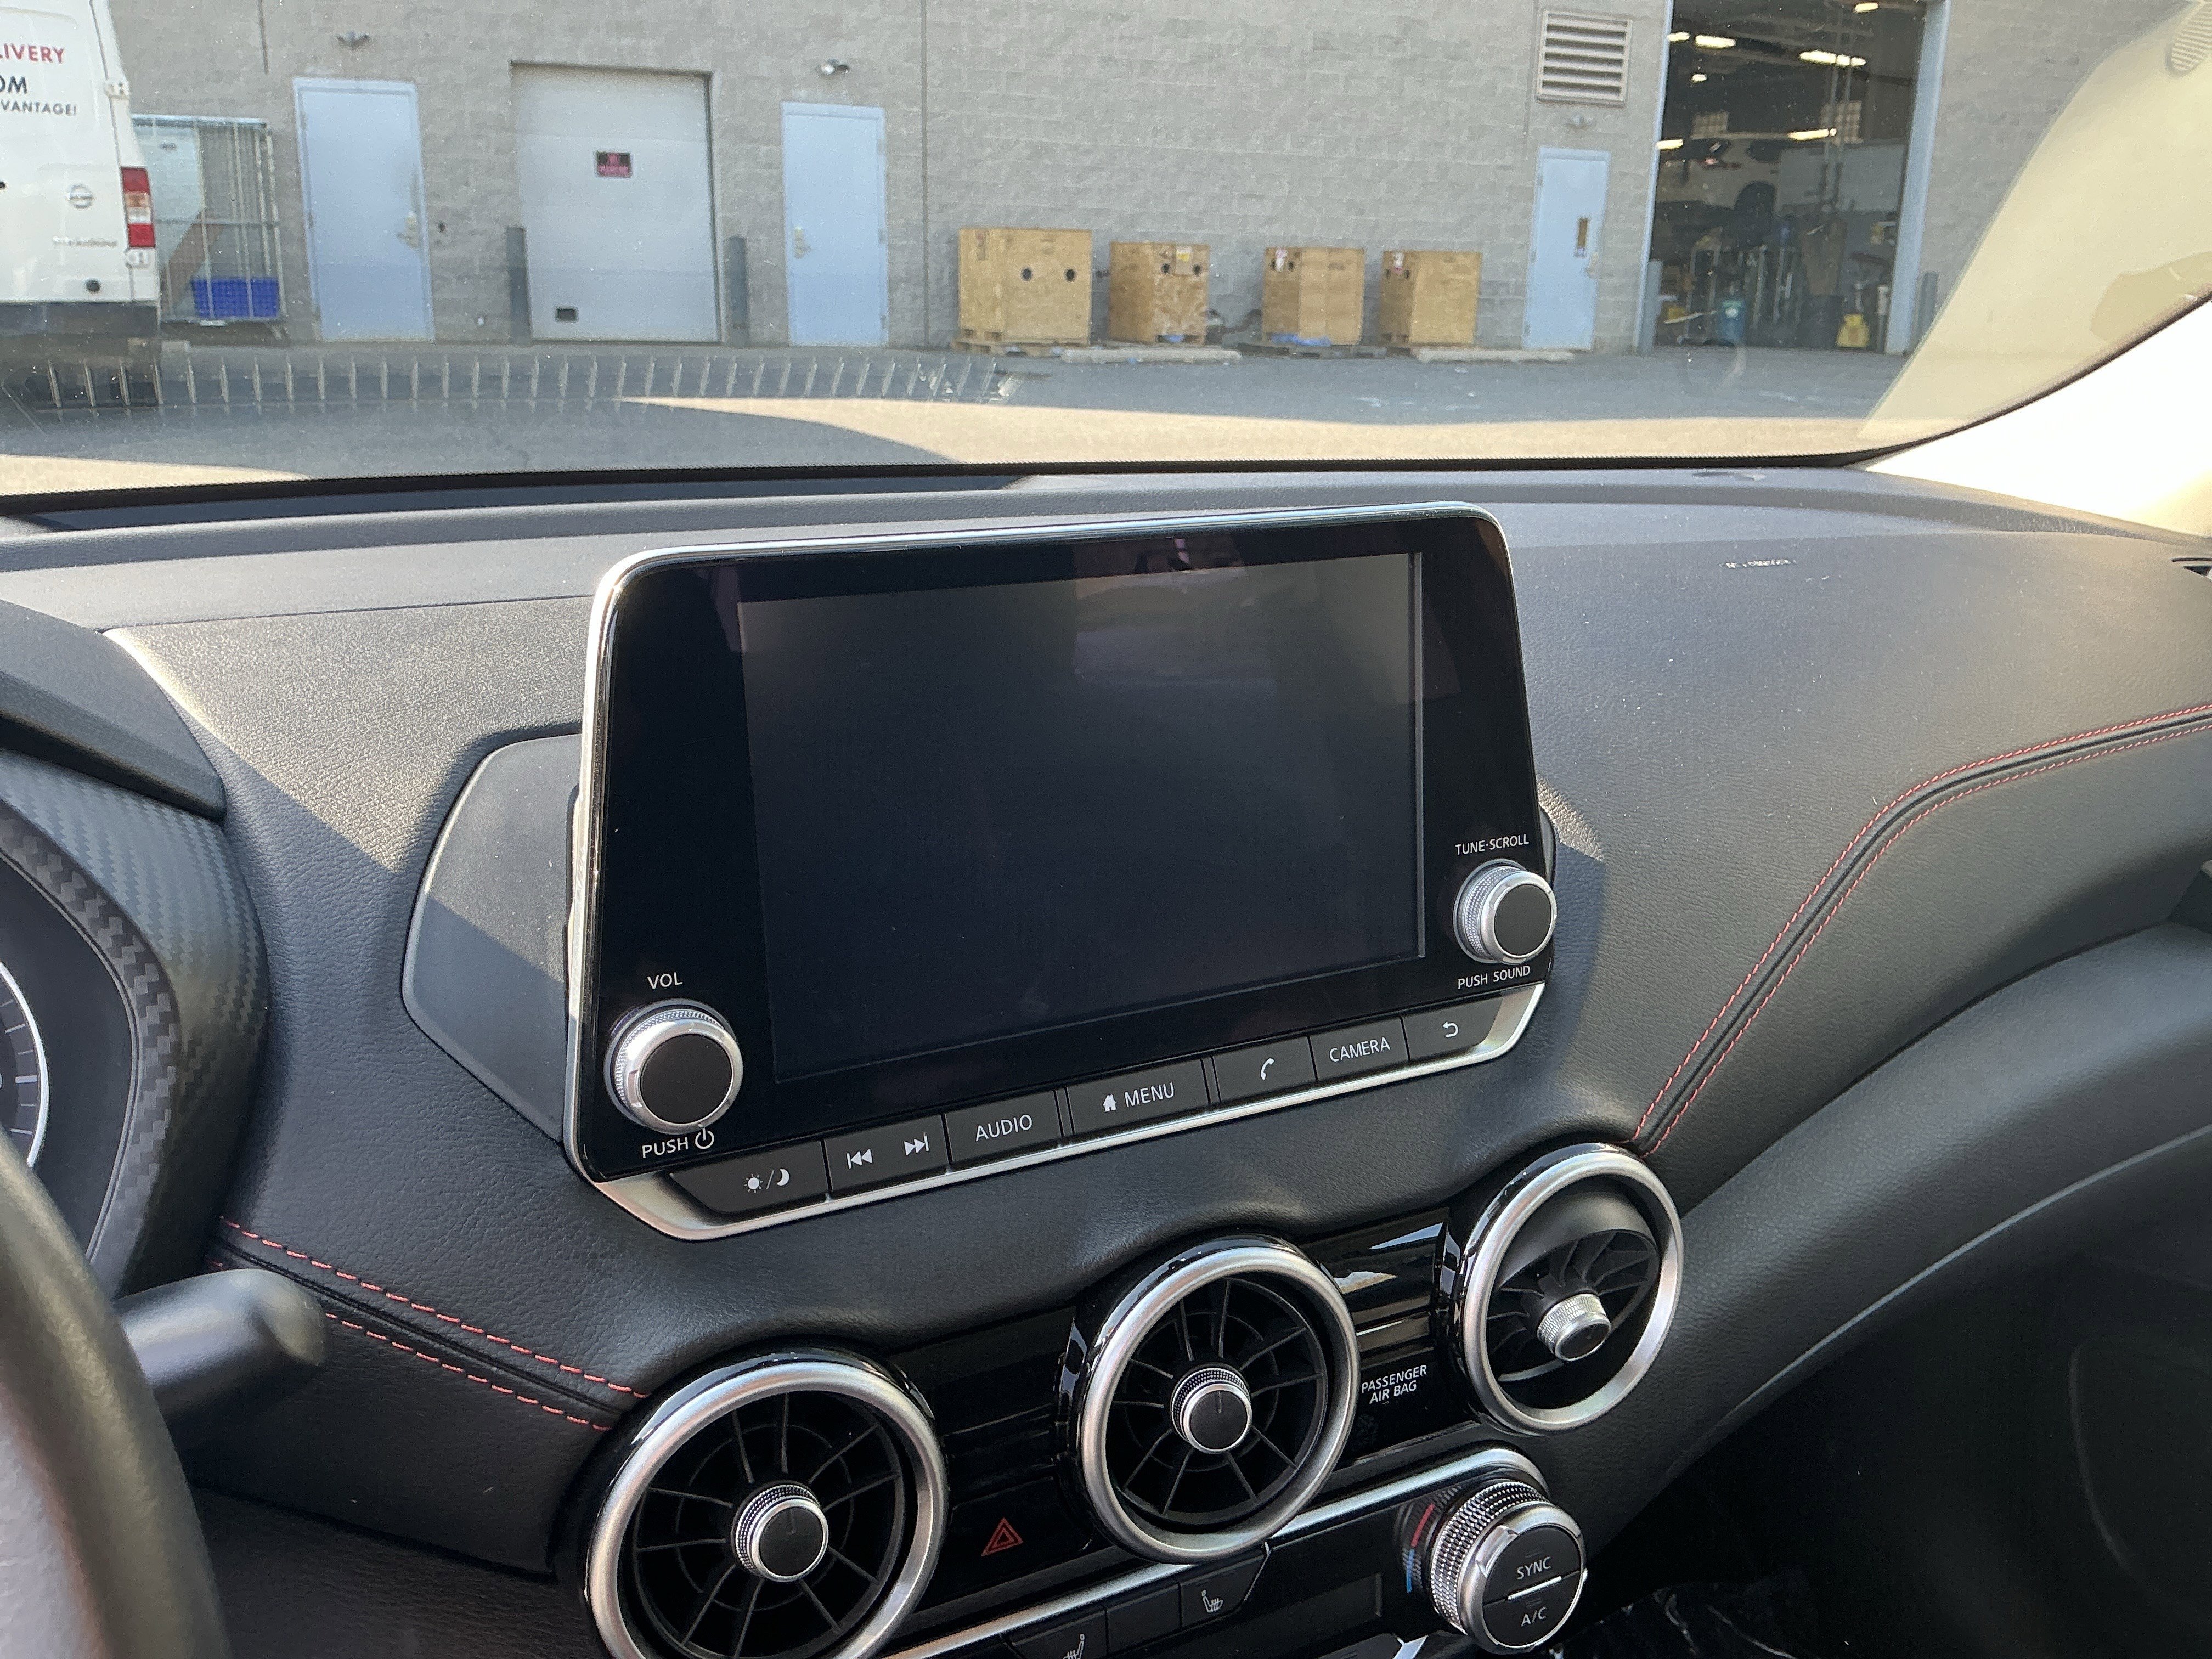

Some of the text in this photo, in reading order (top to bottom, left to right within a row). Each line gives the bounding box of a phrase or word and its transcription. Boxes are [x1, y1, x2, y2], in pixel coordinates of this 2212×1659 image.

[0, 43, 64, 64] IVERY
[647, 972, 683, 989] VOL
[1458, 965, 1531, 990] PUSH SOUND
[1329, 1037, 1391, 1062] CAMERA
[1125, 1082, 1174, 1107] MENU
[975, 1114, 1032, 1142] AUDIO
[642, 1136, 689, 1159] PUSH
[1361, 1364, 1427, 1394] PASSENGER
[1369, 1380, 1417, 1404] AIR BAG
[1517, 1556, 1551, 1581] SYNC
[1521, 1607, 1547, 1627] A/C
